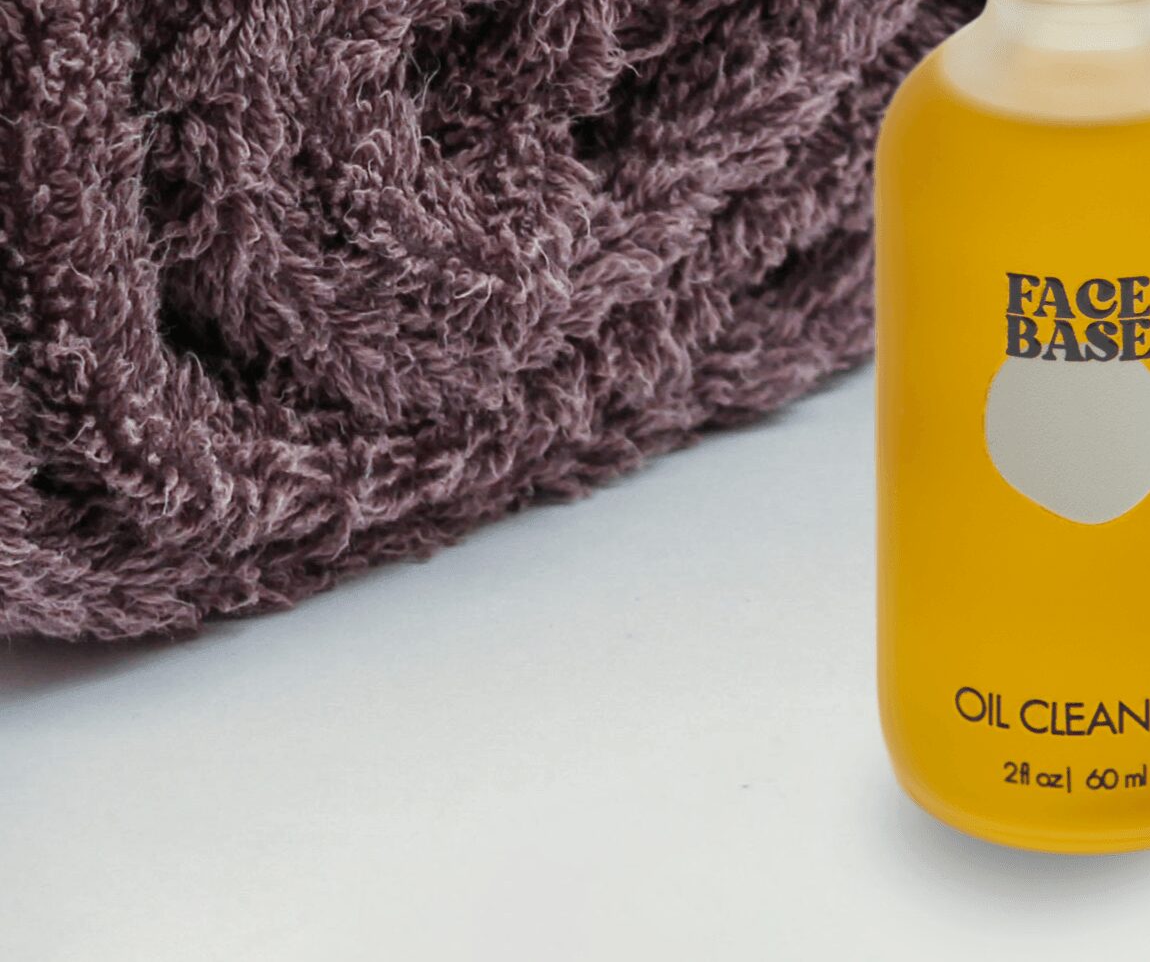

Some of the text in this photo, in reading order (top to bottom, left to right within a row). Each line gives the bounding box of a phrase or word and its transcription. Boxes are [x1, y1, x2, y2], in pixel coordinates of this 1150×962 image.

[954, 686, 1010, 729] OIL
[1085, 768, 1119, 790] 60
[1124, 763, 1147, 788] ml
